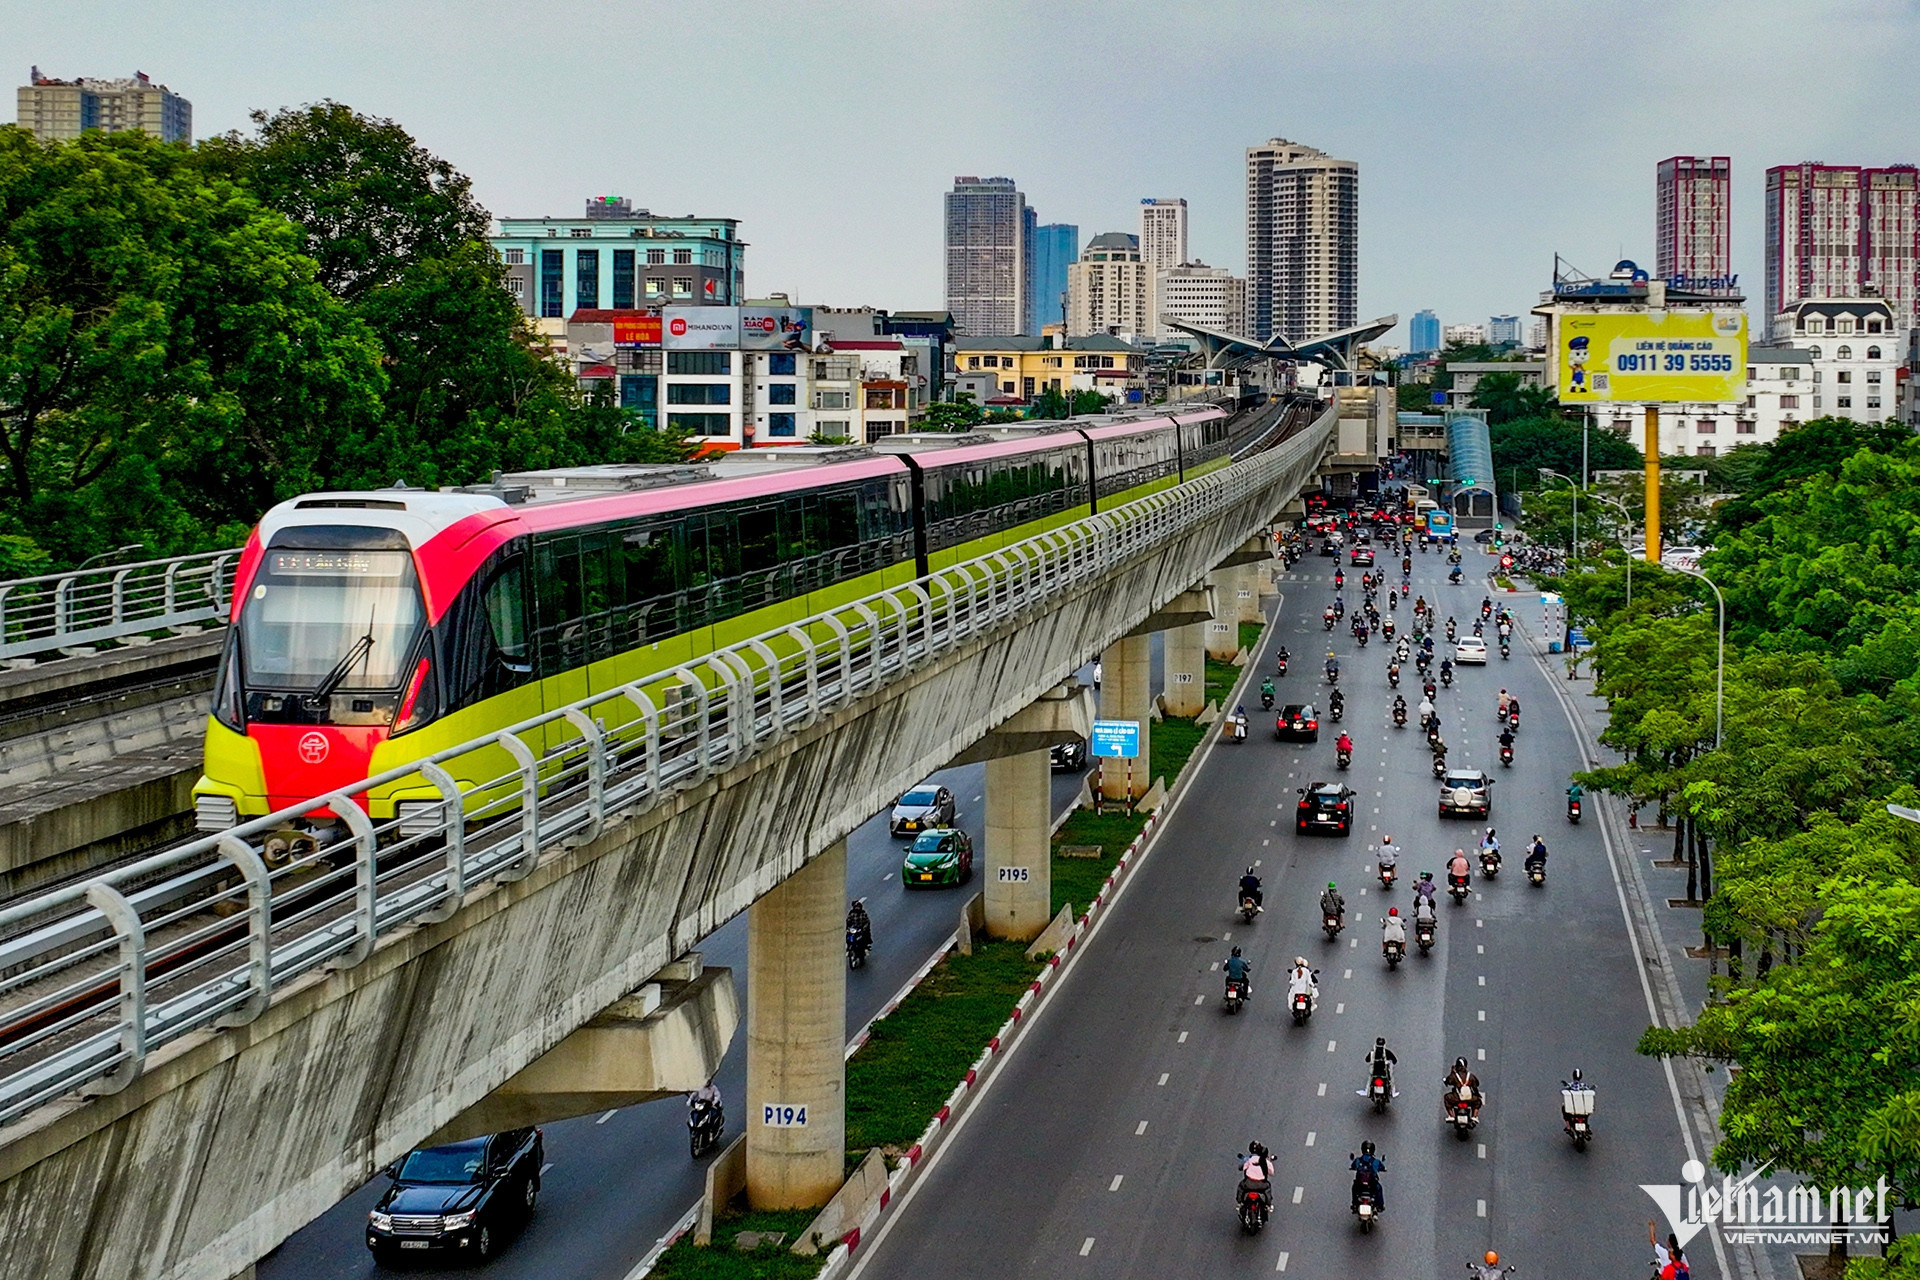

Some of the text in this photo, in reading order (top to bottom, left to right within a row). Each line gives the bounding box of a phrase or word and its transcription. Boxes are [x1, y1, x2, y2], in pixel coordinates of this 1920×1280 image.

[1617, 354, 1732, 371] 0911 39 5555
[999, 868, 1028, 881] P195
[764, 1106, 807, 1125] P194
